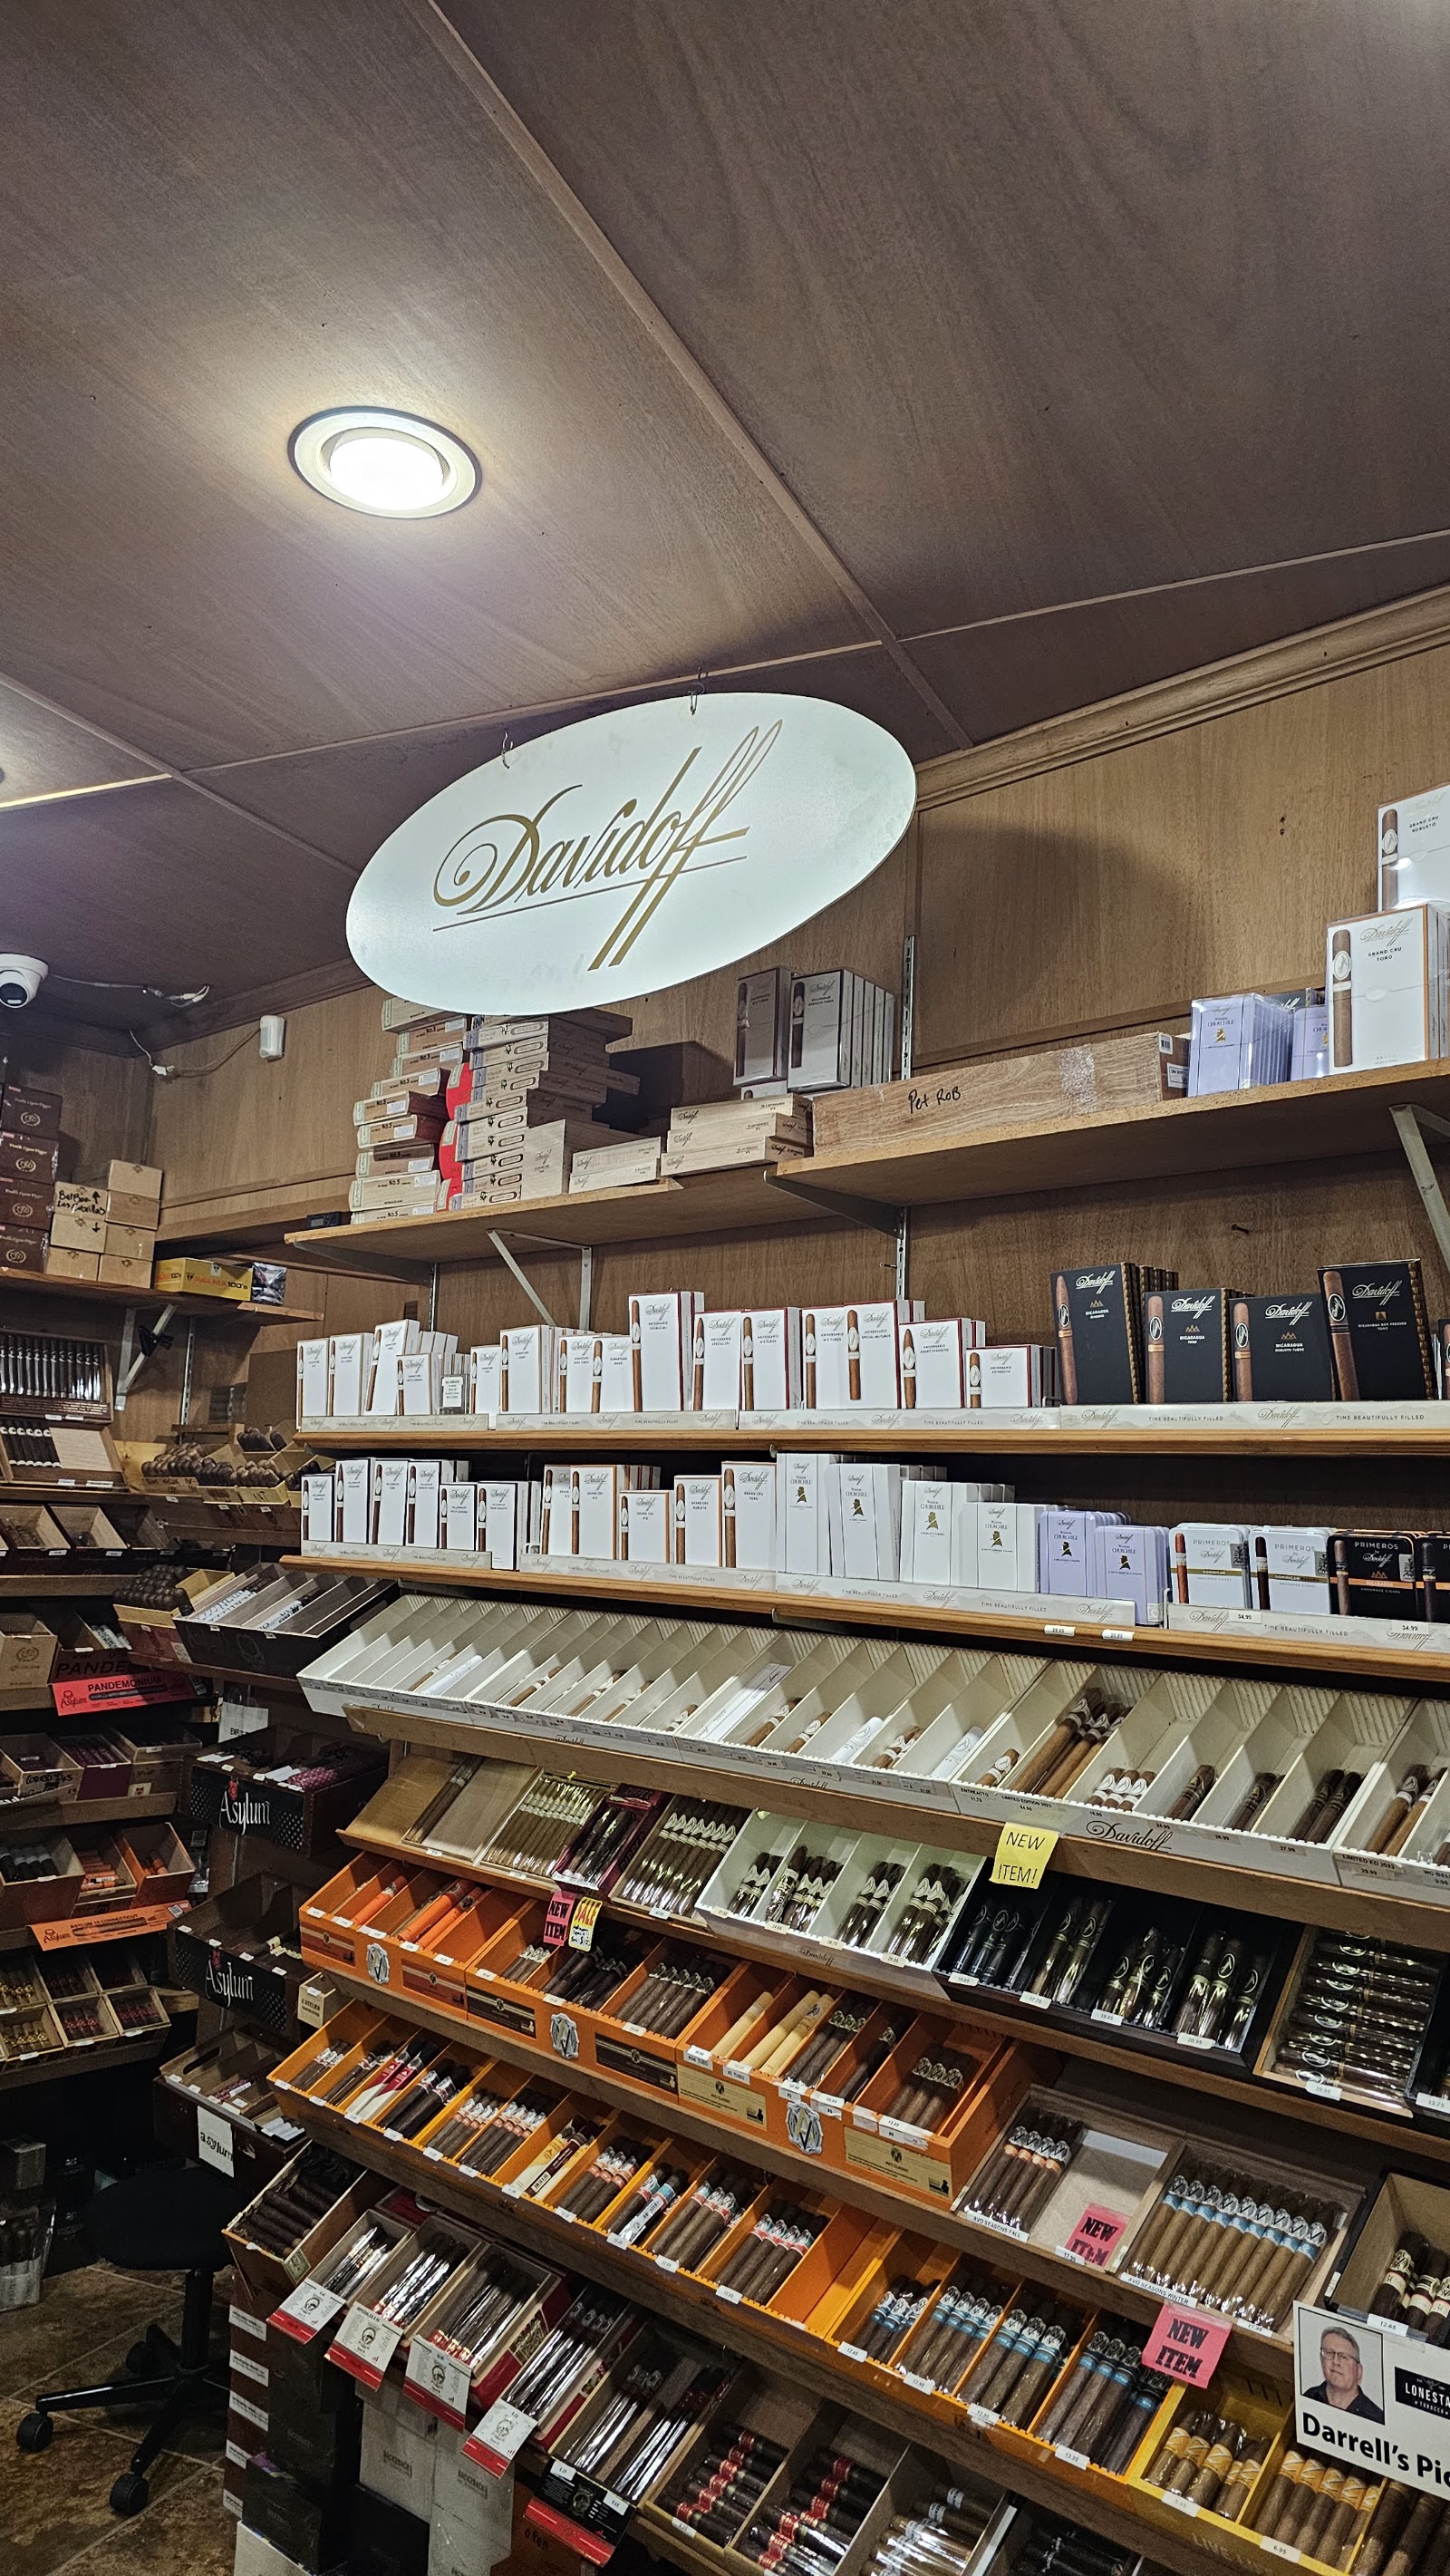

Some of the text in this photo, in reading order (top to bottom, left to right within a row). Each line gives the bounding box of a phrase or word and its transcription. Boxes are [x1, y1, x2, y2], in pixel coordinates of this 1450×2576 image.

[1408, 816, 1439, 828] GRAND CRU
[1411, 822, 1436, 833] ROBUSTO
[433, 719, 784, 972] Davidoff
[1359, 918, 1413, 947] Davidoff
[1368, 949, 1388, 957] GRAND
[908, 1089, 929, 1114] Pet
[1075, 1271, 1116, 1294] Davidoff
[1352, 1280, 1403, 1306] Davidoff
[1171, 1295, 1216, 1319] Davidoff
[1265, 1301, 1313, 1325] Davidoff
[1081, 1409, 1120, 1428] Davidoff
[1258, 1406, 1302, 1428] Davidoff
[1274, 1544, 1316, 1553] PRIMEROS
[1354, 1541, 1399, 1550] PRIMEROS
[1281, 1626, 1323, 1634] BEAUTIFULLY
[88, 1677, 162, 1692] PANDEMONIUM
[219, 1791, 271, 1836] Asylum
[1020, 1798, 1040, 1806] EDITION
[1006, 1831, 1046, 1851] NEW
[1086, 1819, 1174, 1852] Davidoff
[1341, 1854, 1368, 1864] LIMITED
[997, 1864, 1039, 1884] ITEM!
[548, 1900, 570, 1919] NEW
[575, 1899, 602, 1927] SALE
[544, 1921, 566, 1942] ITEM
[205, 1960, 254, 2009] Asylum
[1428, 2100, 1445, 2108] 13.75
[199, 2131, 234, 2163] asylum
[973, 2215, 1021, 2239] AVO SEASONS FALL
[1079, 2216, 1118, 2242] NEW
[1070, 2238, 1110, 2267] ITEM
[1127, 2277, 1189, 2305] AVO SEASONS WINTER
[1166, 2318, 1210, 2349] NEW
[1380, 2319, 1397, 2330] 12.65
[1155, 2345, 1204, 2379] ITEM
[1302, 2411, 1409, 2472] Darrell's
[1273, 2545, 1287, 2555] 6.95
